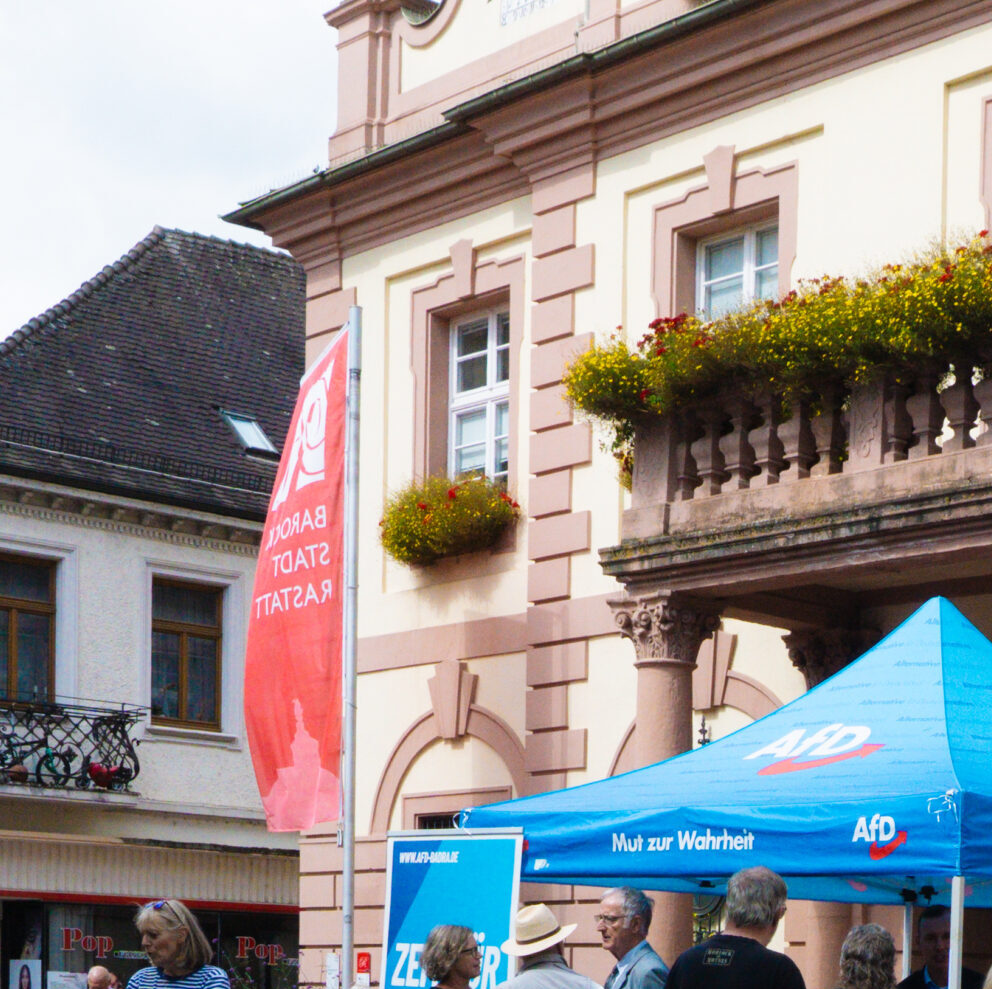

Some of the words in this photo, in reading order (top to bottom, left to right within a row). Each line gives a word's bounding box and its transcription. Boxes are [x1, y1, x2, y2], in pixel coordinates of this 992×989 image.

[742, 723, 872, 760] AfD
[612, 832, 643, 852] Mut
[647, 836, 674, 852] zur
[677, 828, 755, 851] Wahrheit
[852, 813, 896, 843] AfD
[61, 927, 114, 958] Pop
[235, 936, 284, 966] Pop
